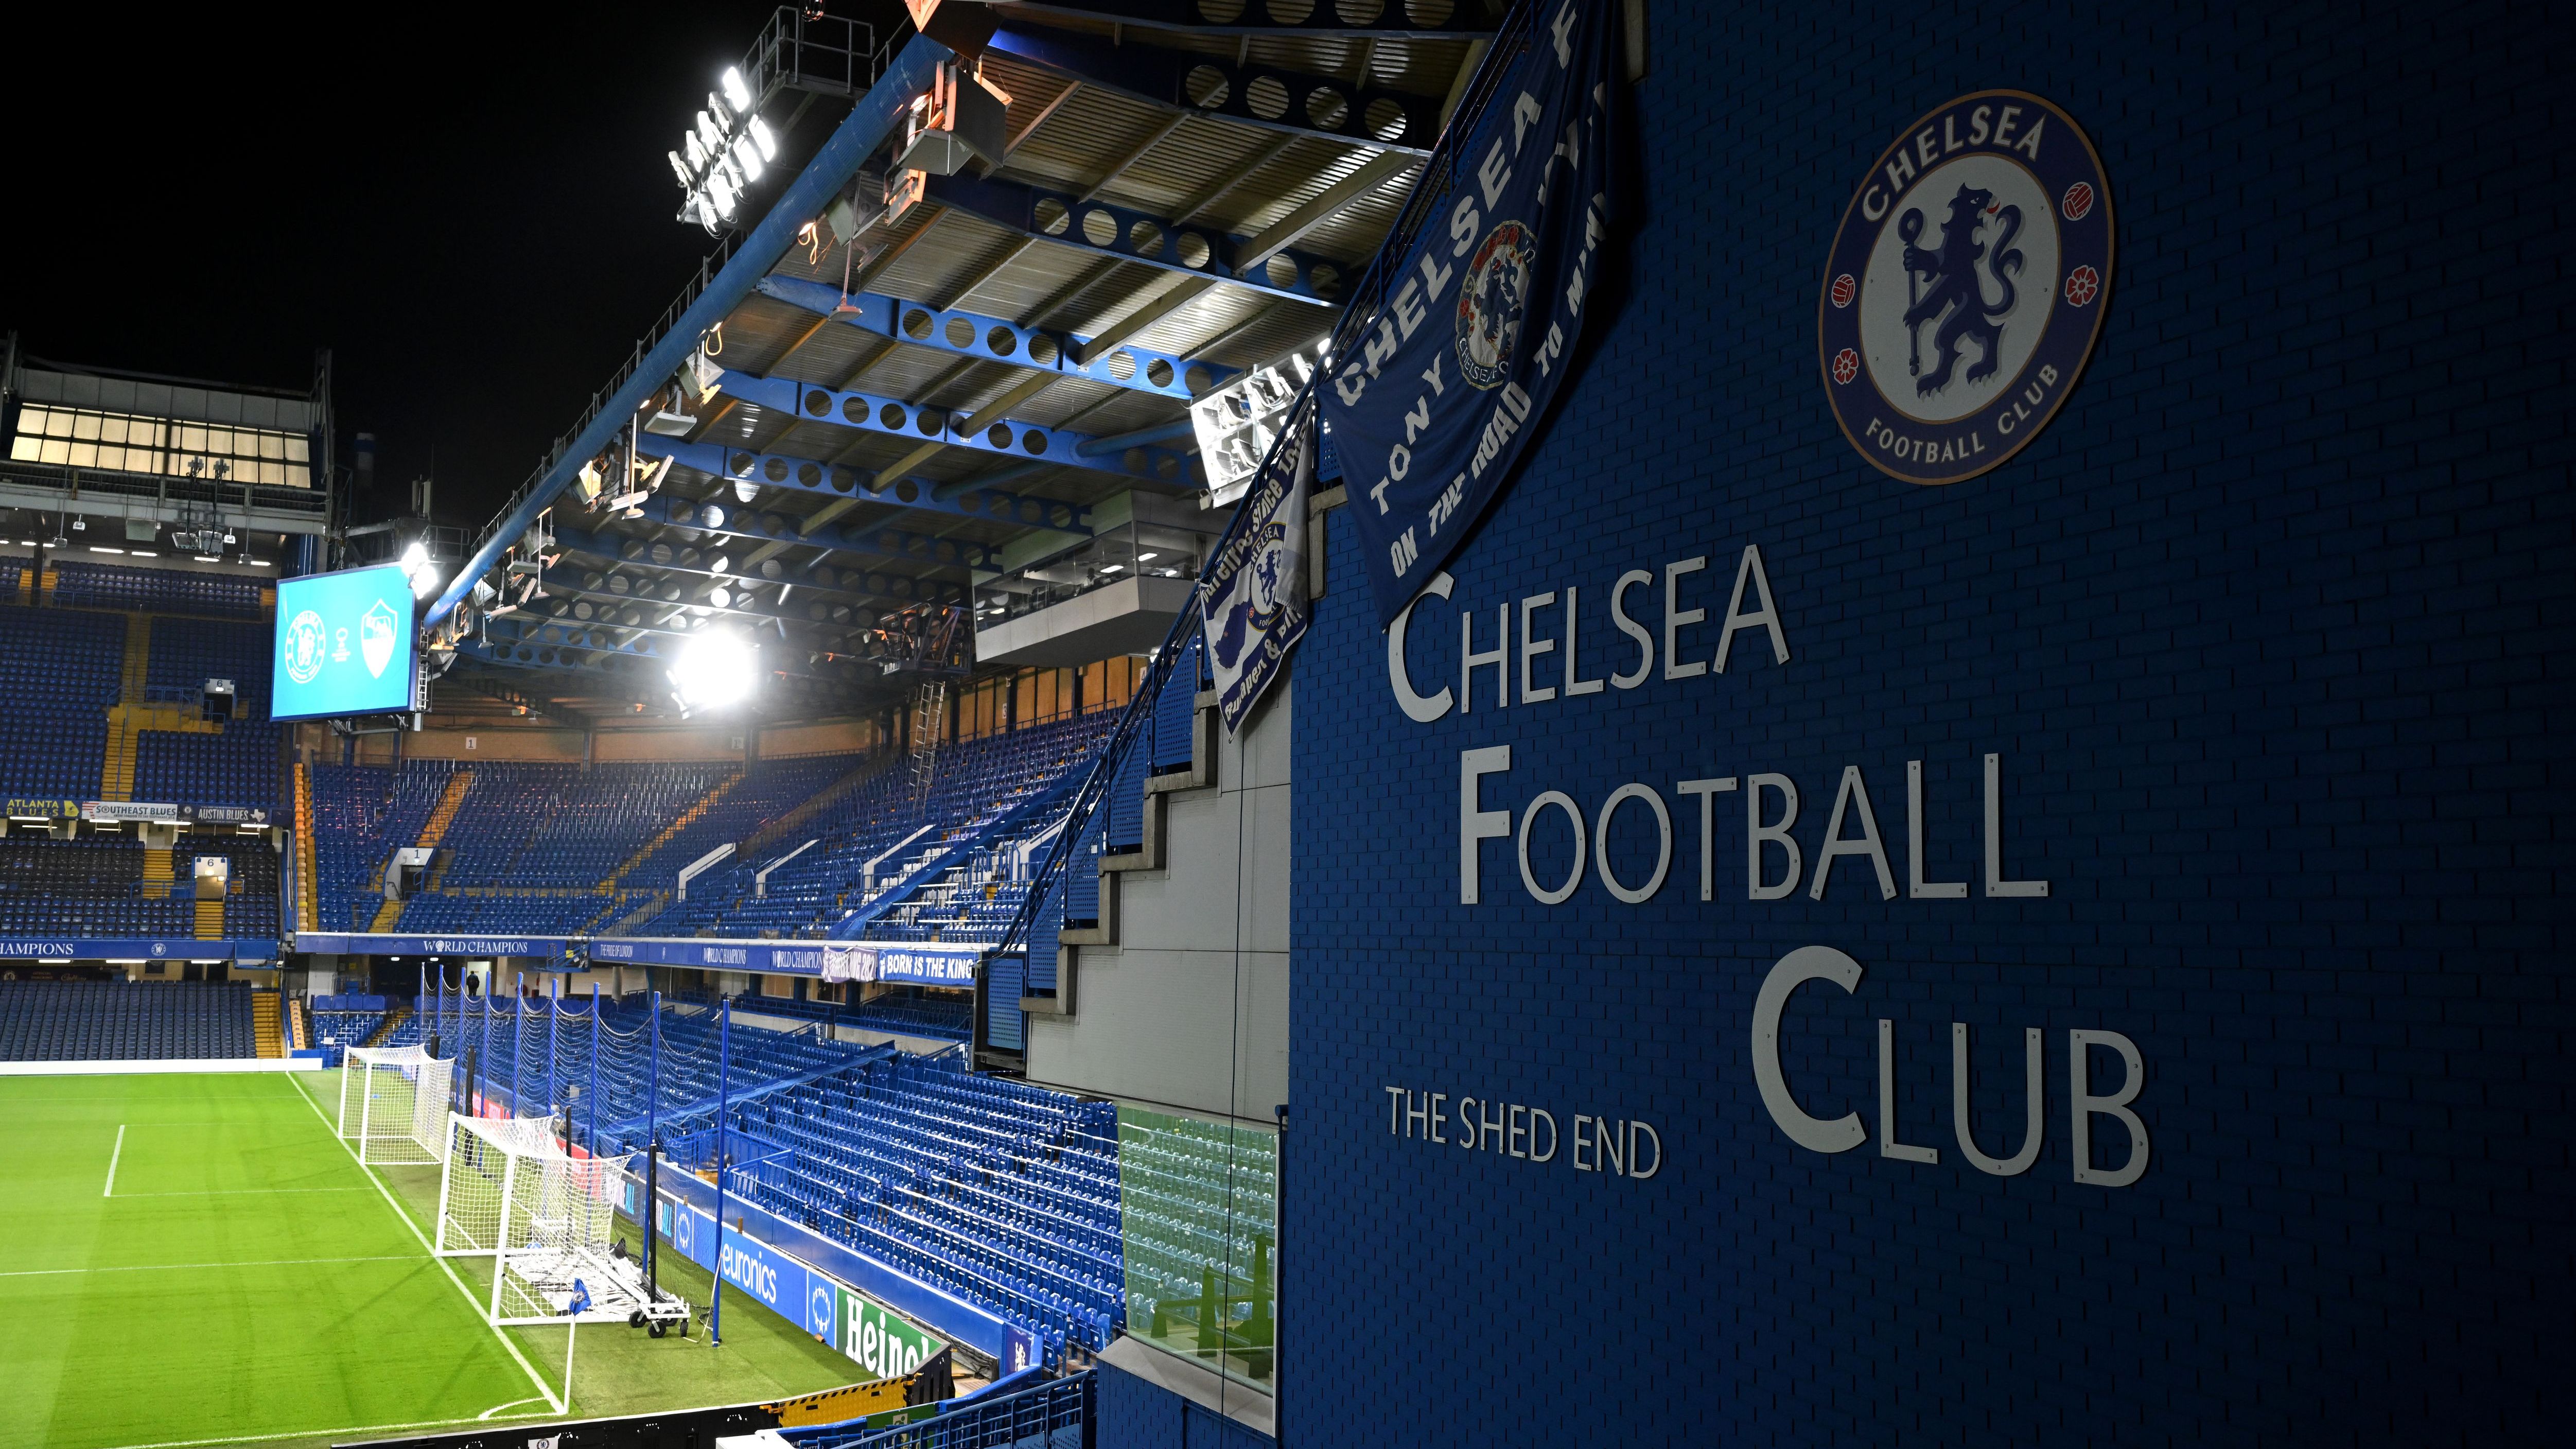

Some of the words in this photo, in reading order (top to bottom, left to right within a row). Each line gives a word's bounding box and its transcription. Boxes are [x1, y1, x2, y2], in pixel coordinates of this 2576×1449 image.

[1862, 105, 2046, 222] CHELSEA
[1336, 90, 1541, 406] CHELSEA
[1865, 417, 1985, 464] FOOTBALL
[1997, 363, 2058, 435] CLUB
[1370, 352, 1444, 515] TONY
[1391, 526, 1418, 578] ON
[1428, 472, 1465, 537] THE
[1534, 321, 1563, 378] TO
[1388, 544, 1790, 723] CHELSEA
[1265, 638, 1282, 660] &
[468, 739, 474, 748] 1
[6, 807, 59, 816] BLUES
[7, 798, 59, 809] ATLANTA
[96, 805, 148, 815] SOUTHEAST
[150, 807, 177, 816] BLUES
[198, 808, 224, 820] AUSTIN
[226, 809, 249, 820] BLUES
[1461, 744, 2049, 904] FOOTBALL
[207, 859, 214, 867] 6
[414, 849, 420, 858] 1
[423, 940, 466, 952] WORLD
[468, 941, 528, 953] CHAMPIONS
[704, 947, 719, 963] WORLD
[719, 948, 746, 965] CHAMPIONS
[773, 950, 791, 968] WORLD
[792, 951, 822, 969] CHAMPION
[887, 954, 913, 974] BORN
[914, 956, 924, 976] IS
[926, 957, 946, 978] THE
[947, 958, 974, 979] KING
[1751, 945, 2150, 1187] CLUB
[1385, 1086, 1447, 1144] THE
[1458, 1096, 1557, 1163] SHED
[1573, 1114, 1660, 1179] END
[723, 1243, 777, 1304] euronics
